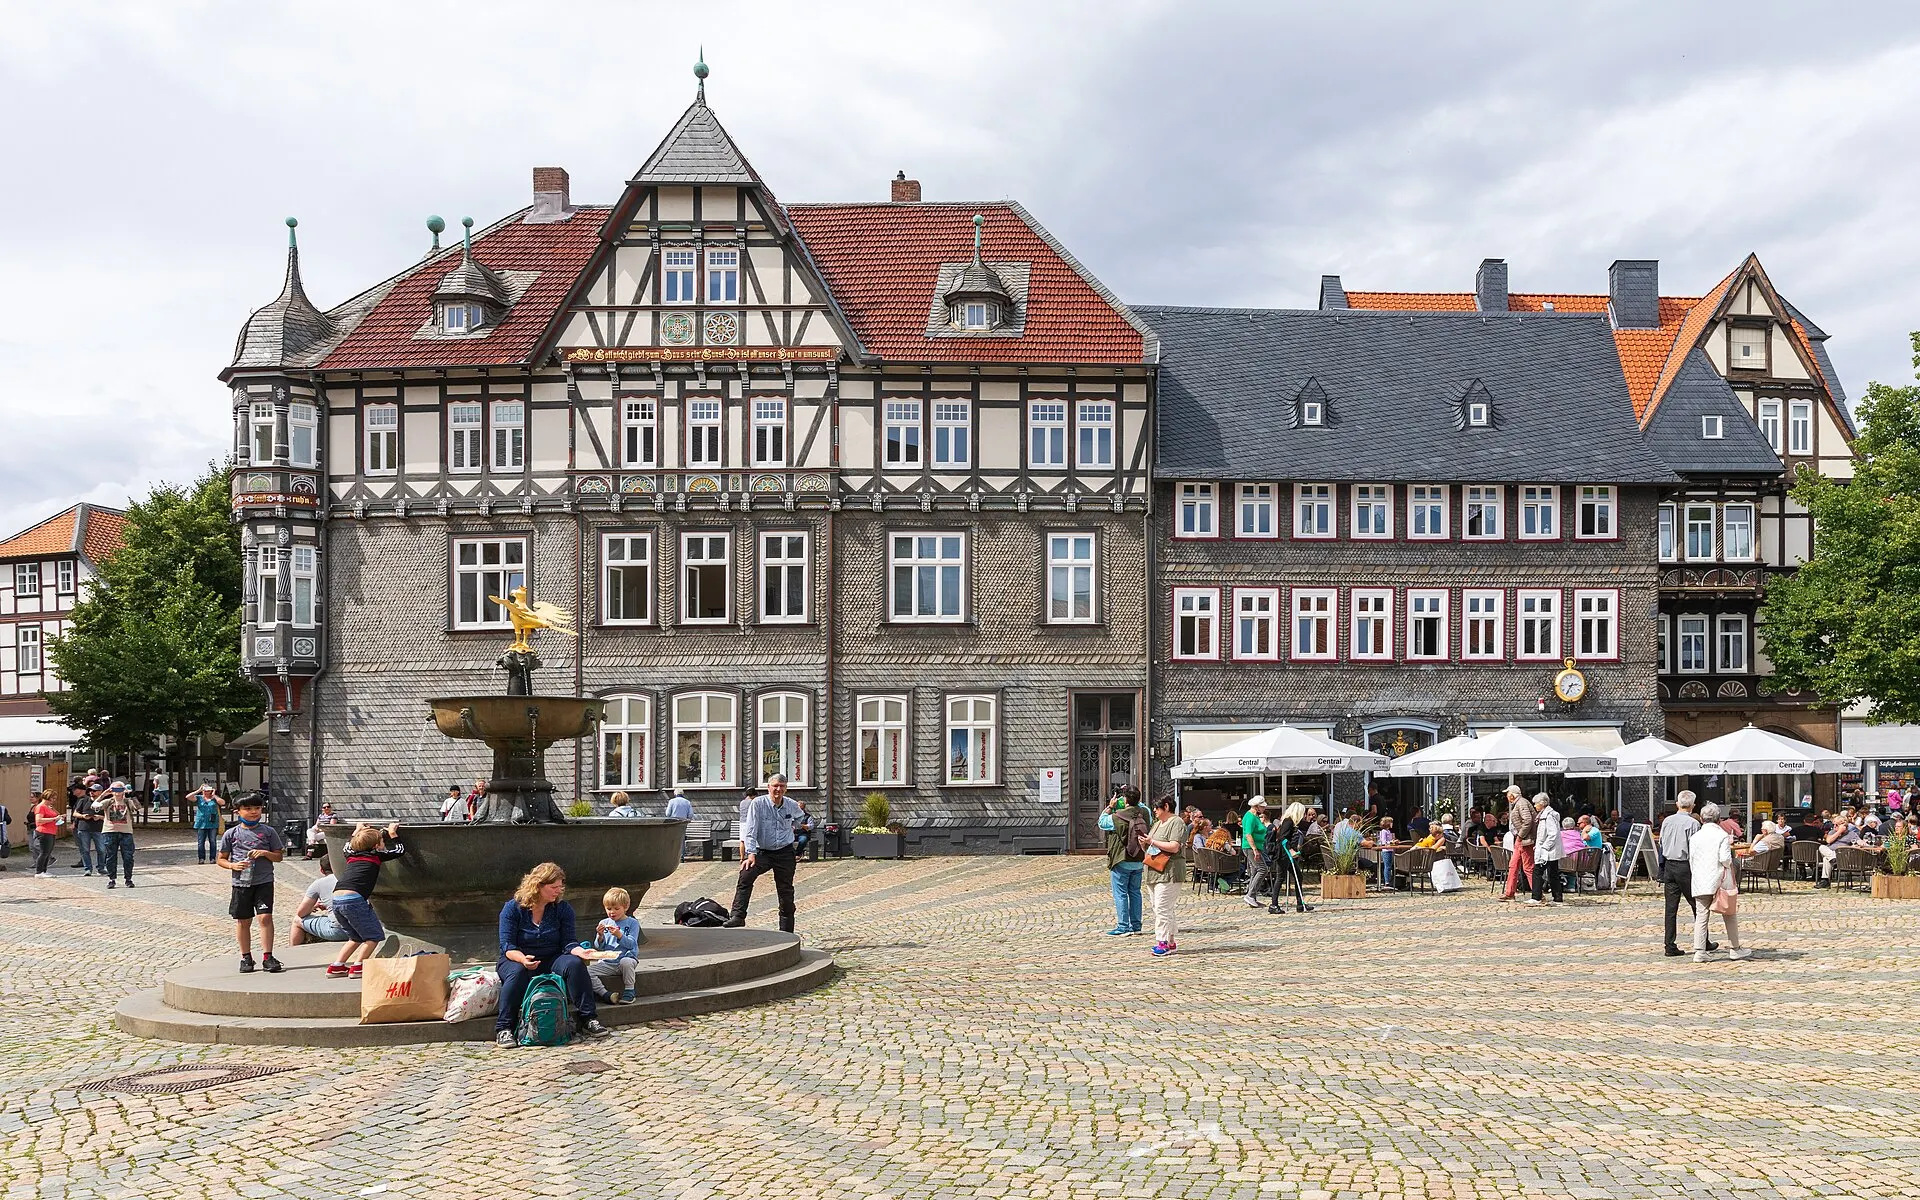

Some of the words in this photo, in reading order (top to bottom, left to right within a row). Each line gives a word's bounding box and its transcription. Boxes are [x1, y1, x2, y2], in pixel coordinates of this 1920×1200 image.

[1318, 757, 1342, 765] Central
[1457, 760, 1476, 768] Central
[1778, 761, 1805, 769] Central
[386, 980, 412, 998] H&M
